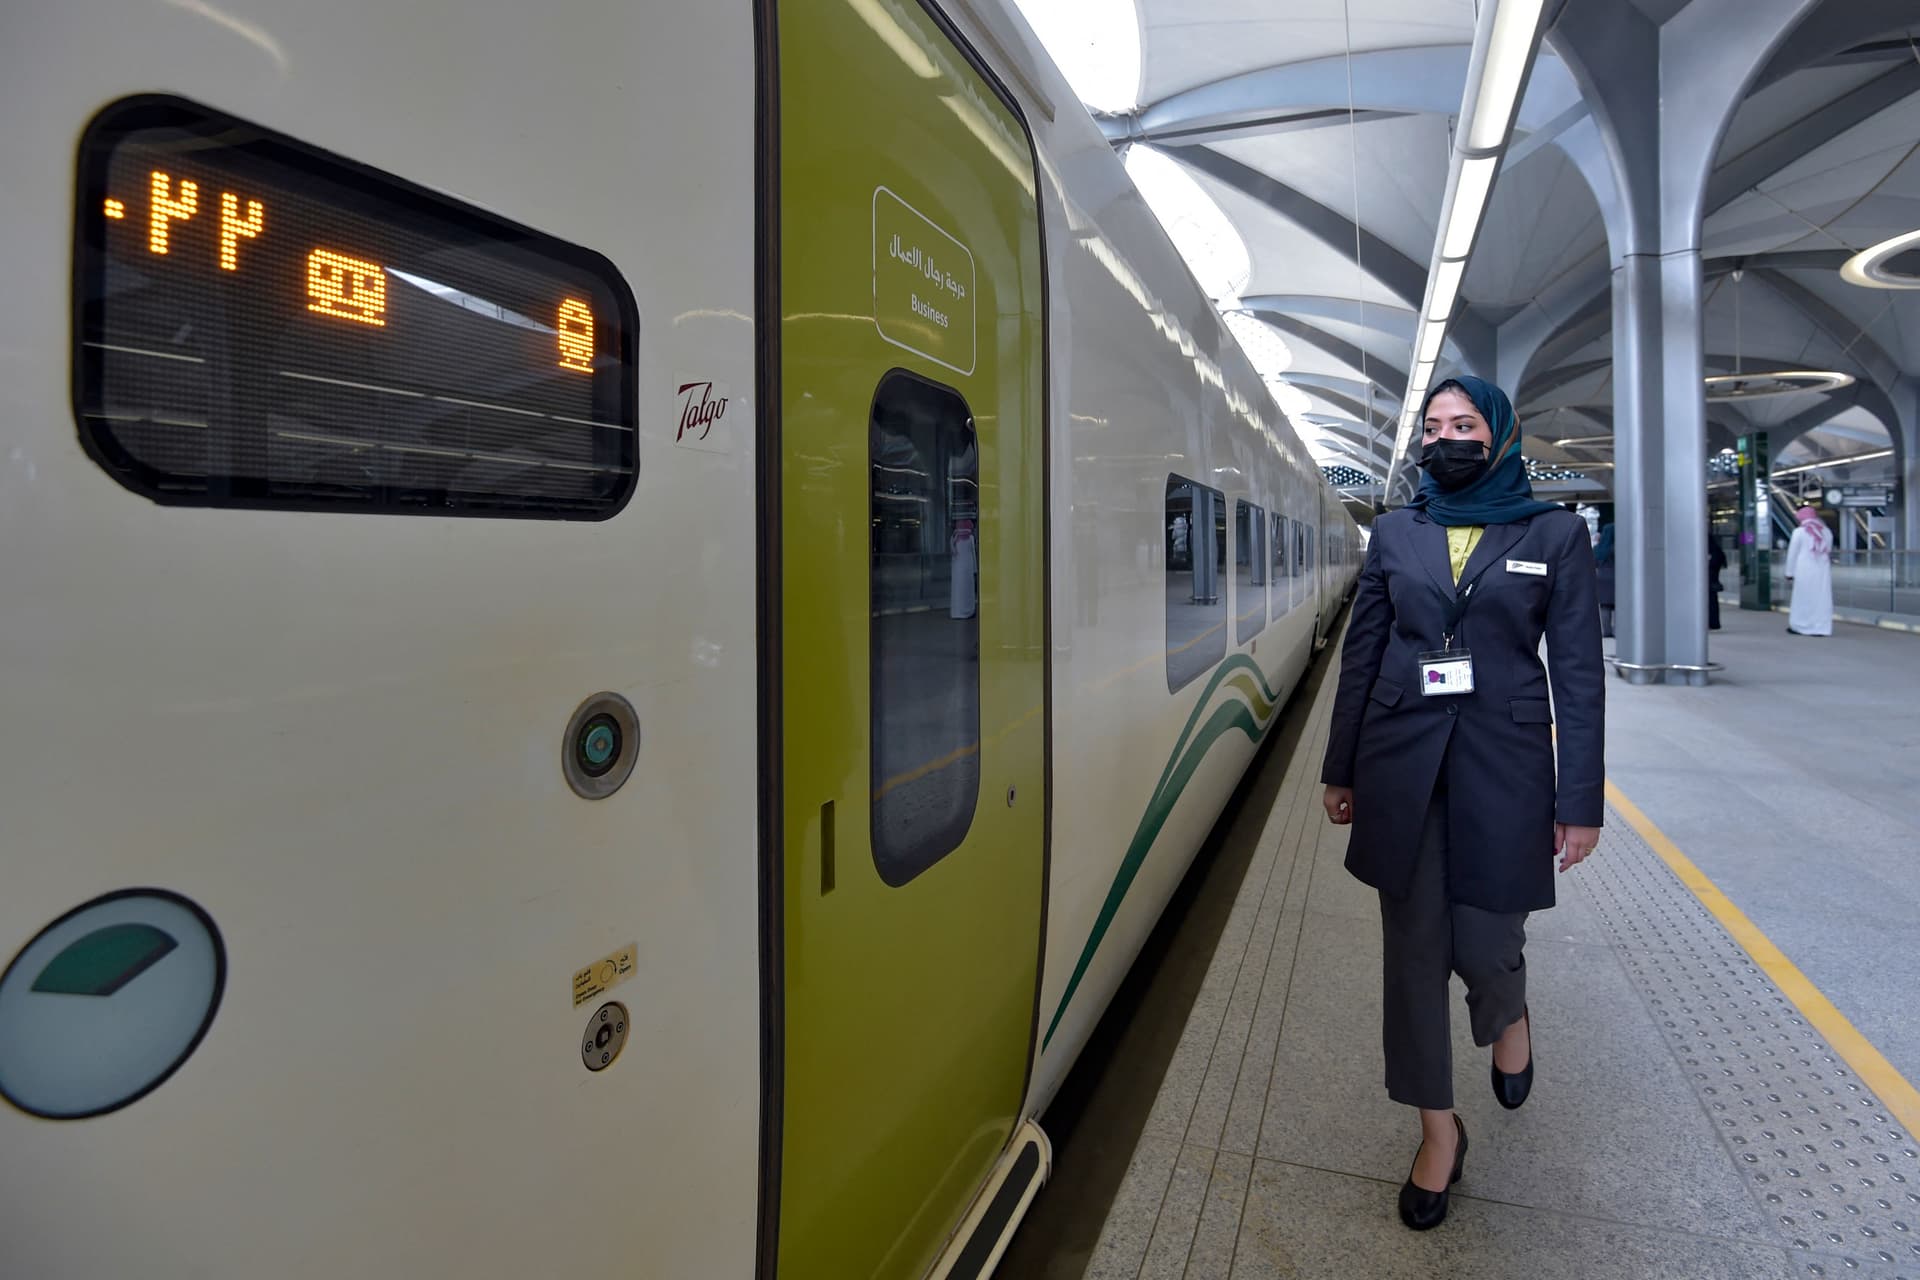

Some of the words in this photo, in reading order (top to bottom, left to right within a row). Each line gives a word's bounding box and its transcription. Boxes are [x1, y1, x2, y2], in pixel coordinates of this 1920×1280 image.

[924, 256, 944, 290] رجال
[946, 272, 965, 300] درجة
[911, 293, 949, 328] Business
[676, 381, 729, 443] Talgo
